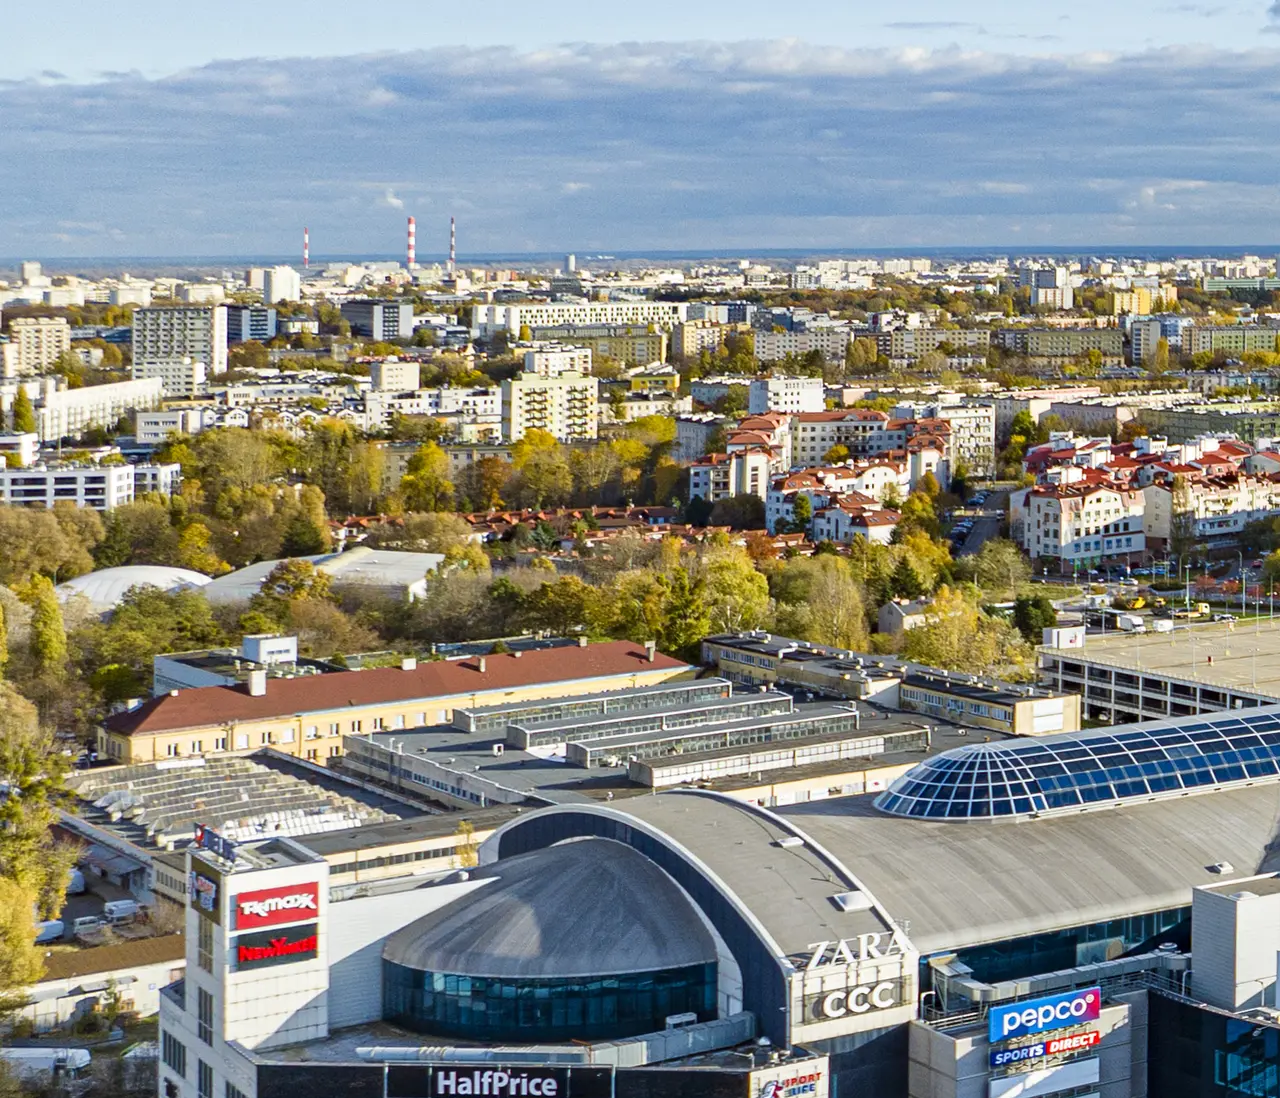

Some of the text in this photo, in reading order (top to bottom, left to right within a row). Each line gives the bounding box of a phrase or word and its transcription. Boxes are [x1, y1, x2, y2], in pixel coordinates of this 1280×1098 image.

[807, 931, 911, 971] ZARA
[822, 981, 895, 1018] CCC
[1002, 997, 1088, 1035] pepco
[994, 1032, 1098, 1065] SPORTS DIRECT
[436, 1071, 558, 1096] HalfPrice
